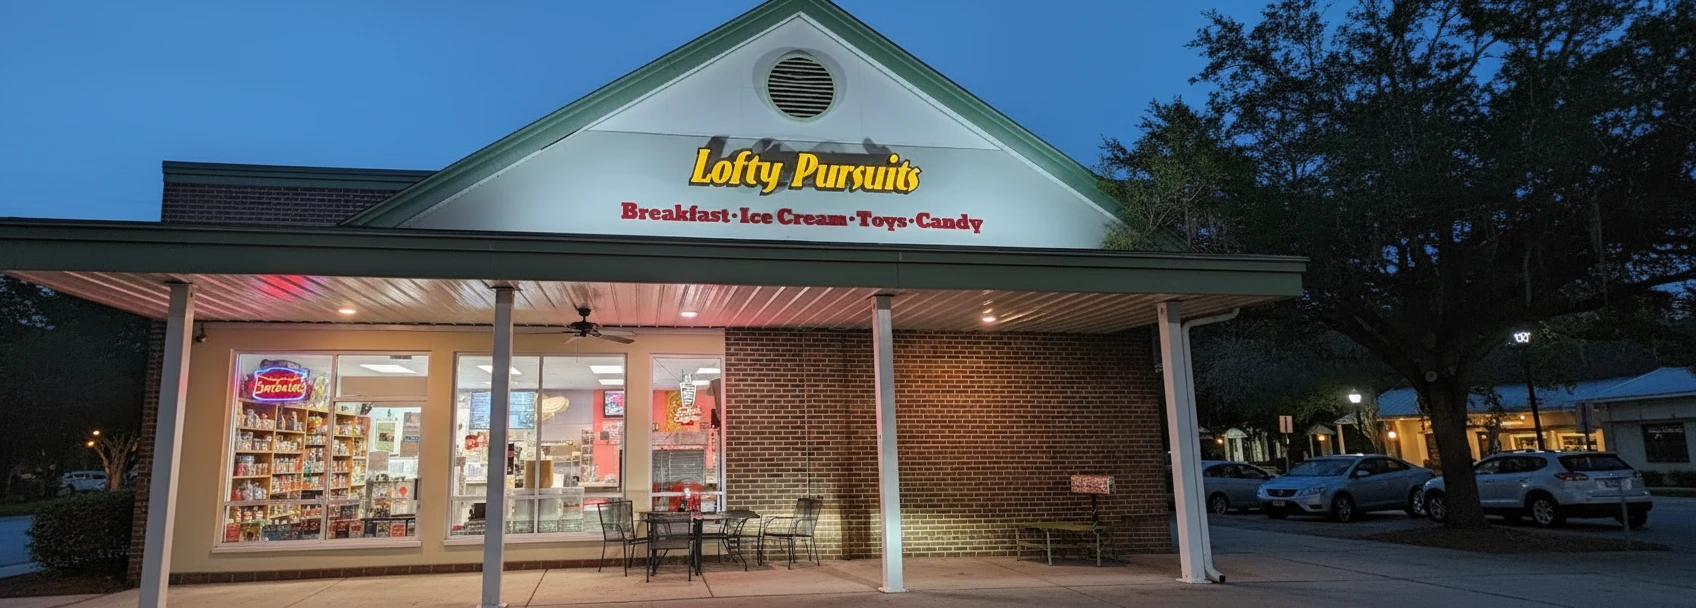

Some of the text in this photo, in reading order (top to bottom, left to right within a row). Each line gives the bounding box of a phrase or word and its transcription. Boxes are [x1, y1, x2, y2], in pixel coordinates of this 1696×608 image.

[689, 147, 921, 195] Lofty Pursuits
[621, 202, 983, 234] Breakfast Ice Cream Toys Candy
